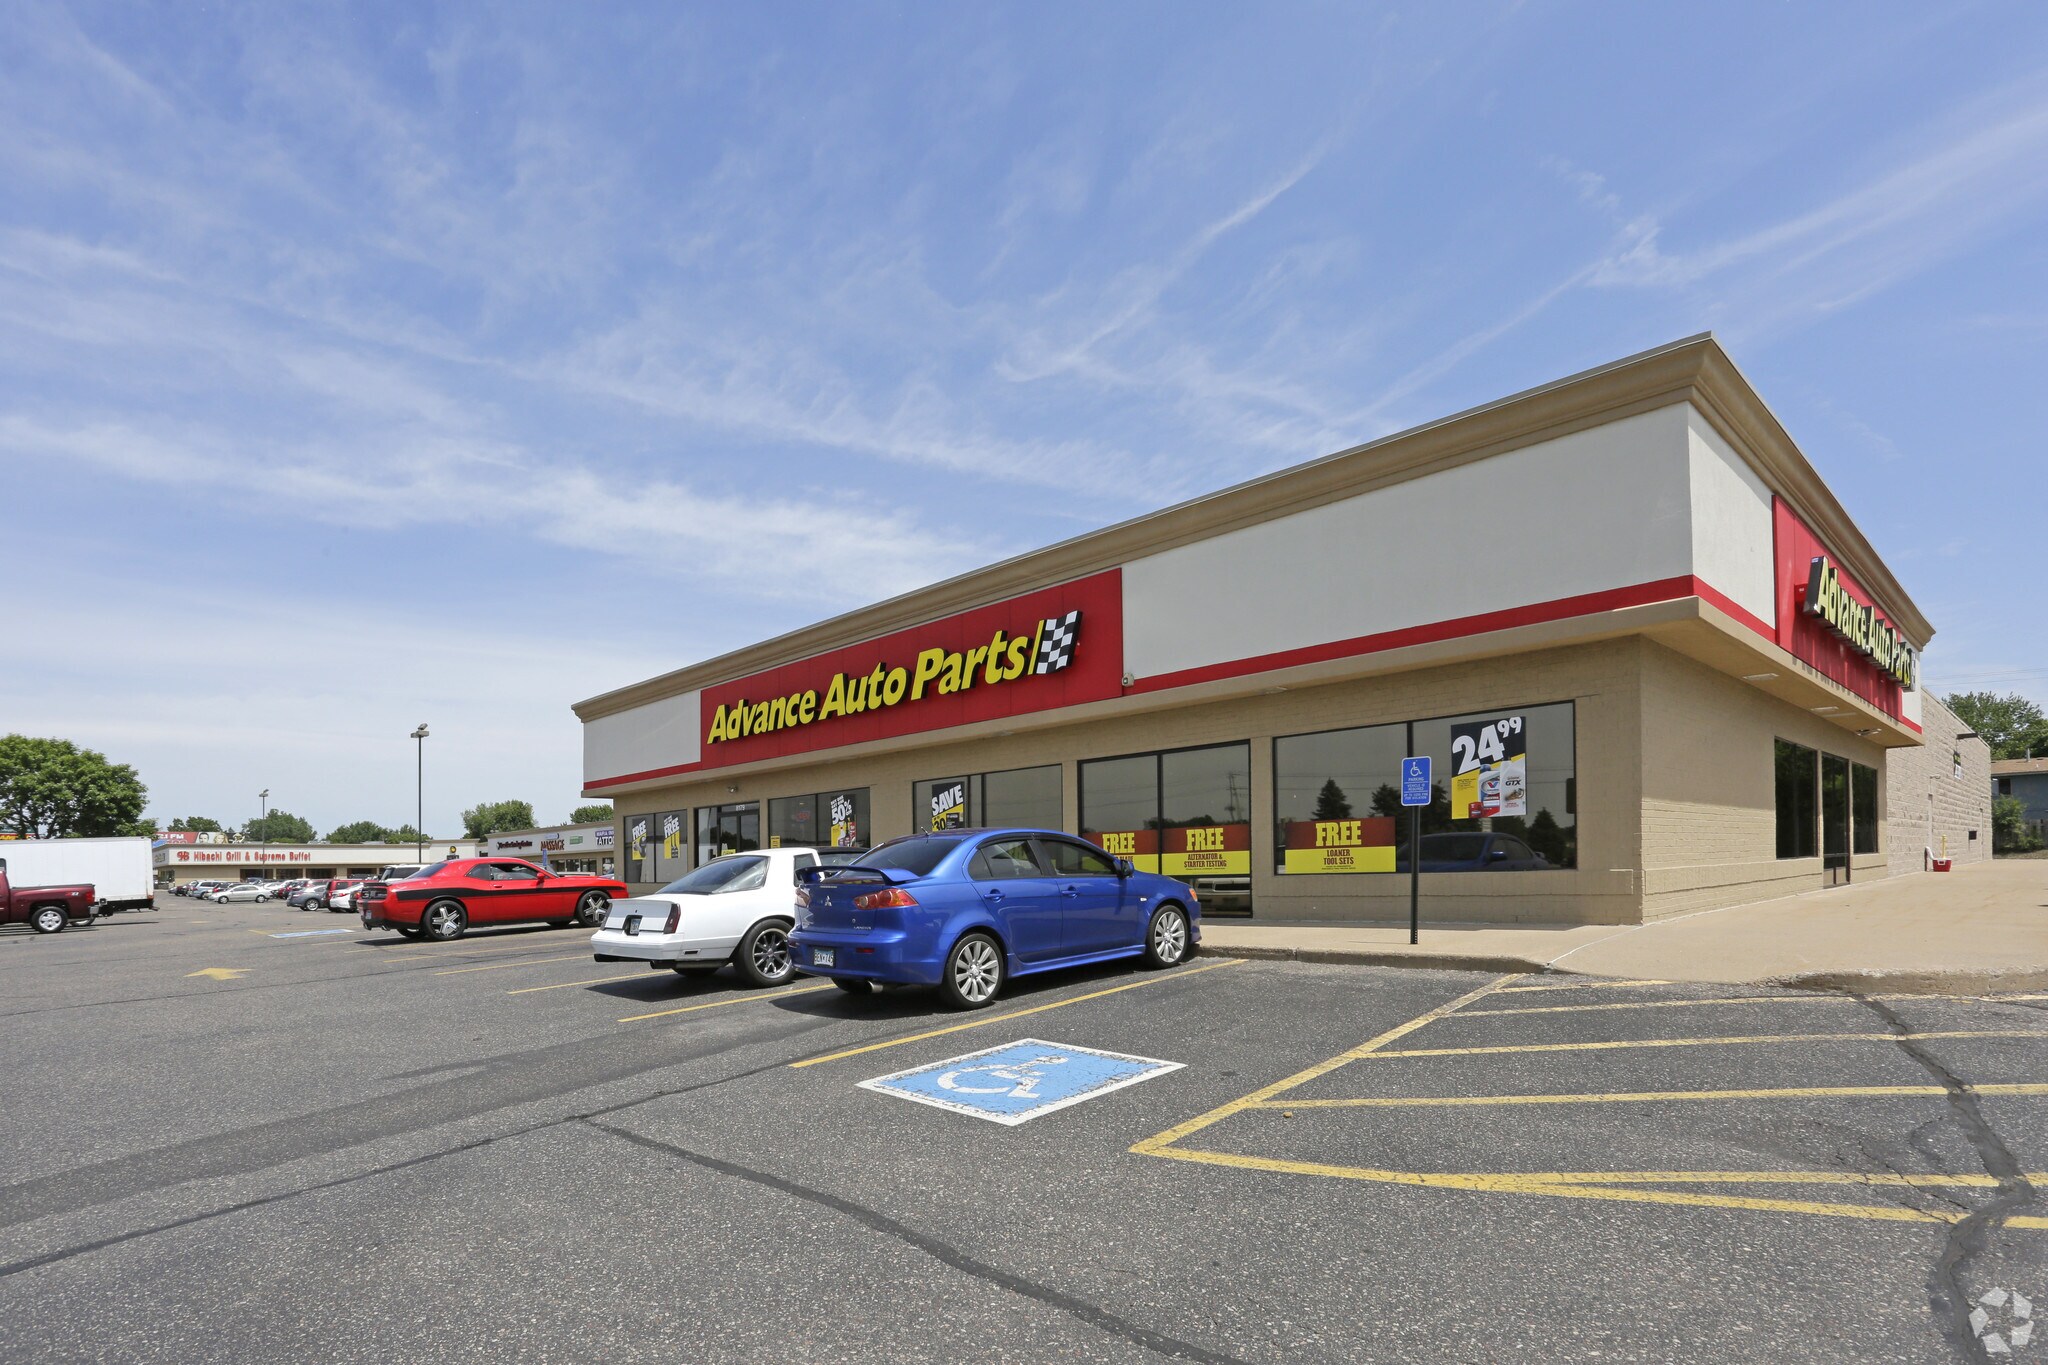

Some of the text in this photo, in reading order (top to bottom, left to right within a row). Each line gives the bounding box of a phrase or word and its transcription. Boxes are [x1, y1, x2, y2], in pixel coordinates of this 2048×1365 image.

[1817, 556, 1911, 685] Advance Auto Parts
[707, 630, 1029, 744] Advance Auto Parts
[1505, 779, 1522, 787] GTX
[932, 784, 964, 816] SAVE
[632, 820, 647, 840] FREE
[664, 817, 680, 839] FREE
[1315, 820, 1362, 847] FREE
[540, 839, 565, 851] MASSAGE
[1102, 832, 1136, 854] FREE
[1186, 827, 1224, 851] FREE
[194, 851, 222, 862] Hibachi
[226, 851, 241, 862] Grill
[245, 851, 250, 861] &
[254, 851, 286, 864] Supreme
[289, 851, 311, 862] Buffet
[1323, 856, 1354, 865] TOOL SETS
[1327, 849, 1351, 857] LOANER
[1184, 860, 1205, 868] STARTER
